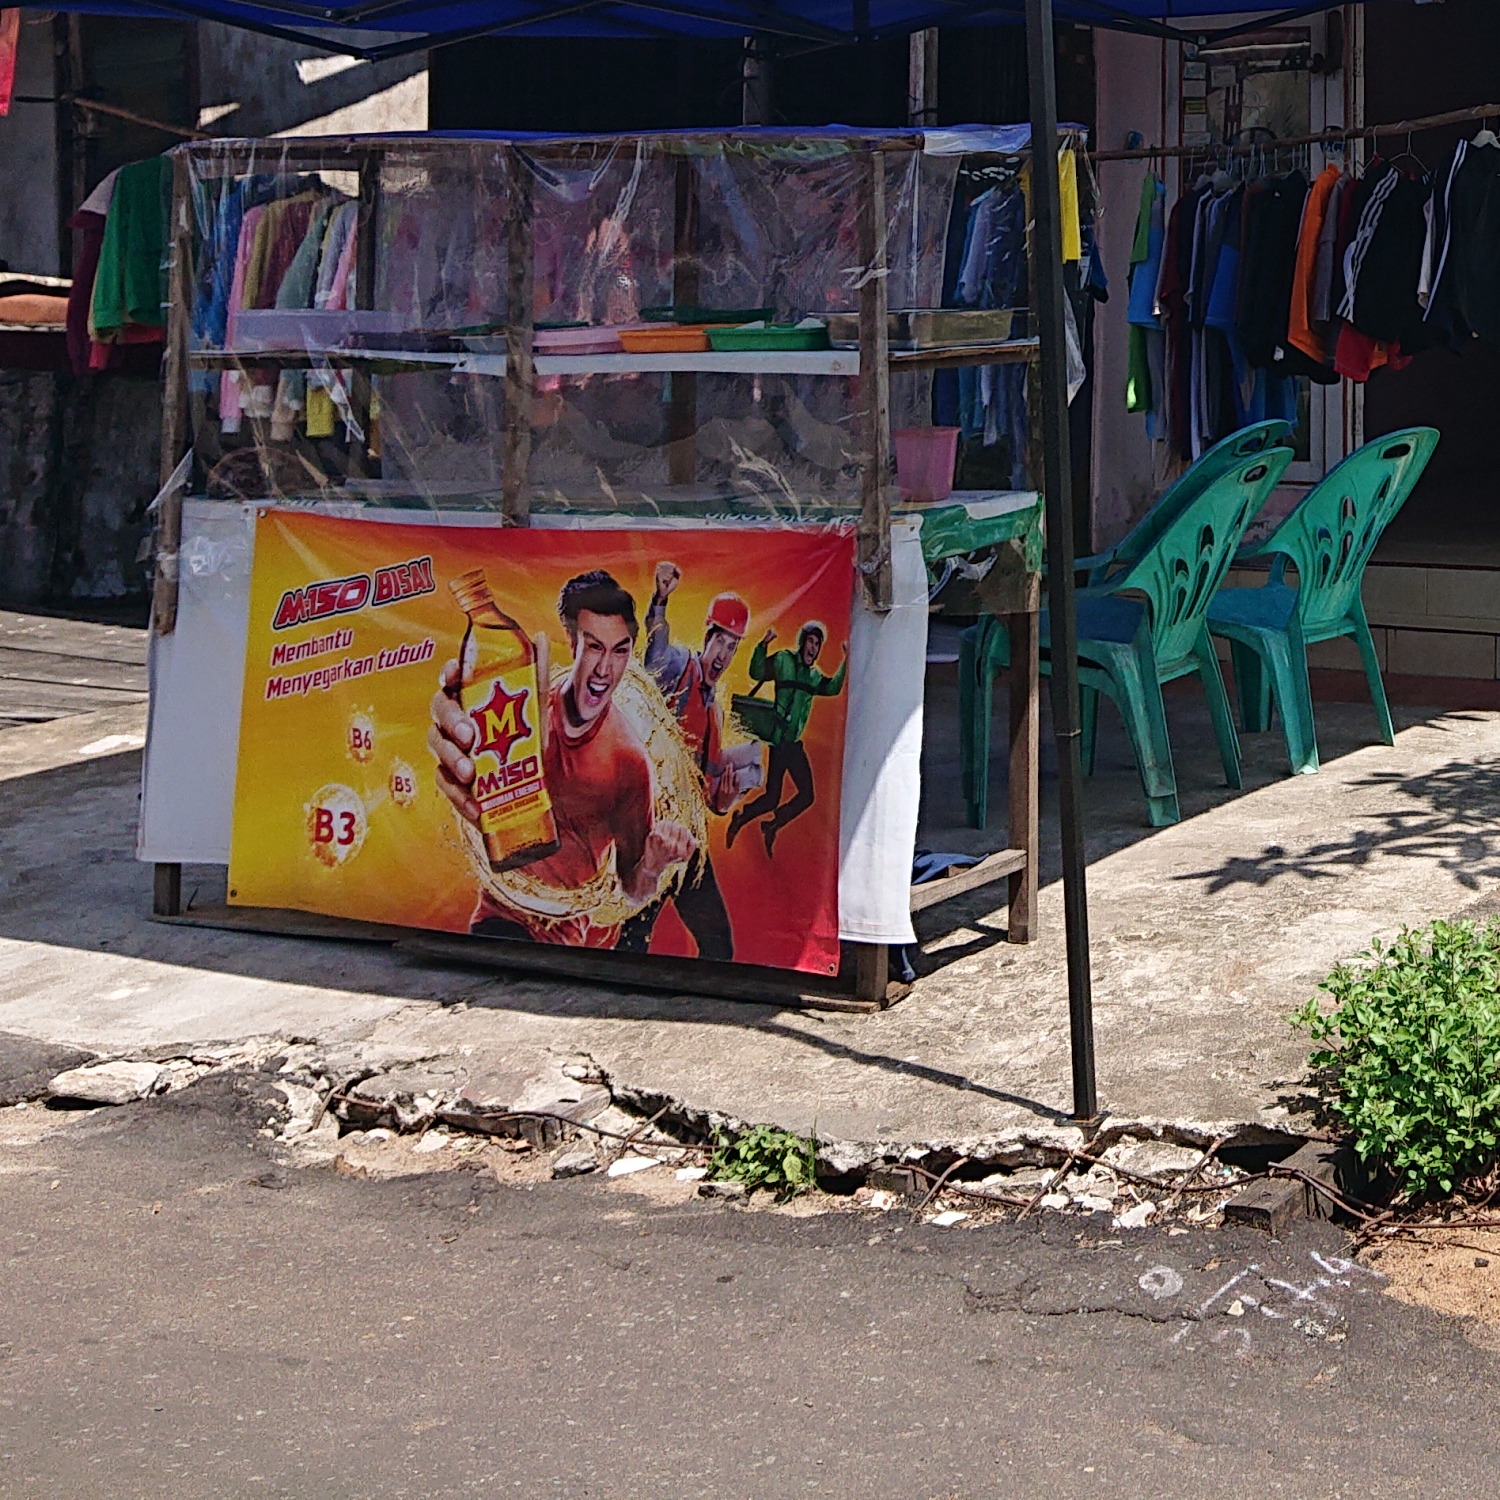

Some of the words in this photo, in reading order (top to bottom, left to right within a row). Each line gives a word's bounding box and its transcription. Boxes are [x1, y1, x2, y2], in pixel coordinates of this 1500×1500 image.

[274, 576, 370, 630] M-150
[373, 558, 434, 605] BISA!
[271, 627, 353, 667] Membantu
[266, 657, 374, 700] Menyegarkan
[378, 638, 434, 670] tubuh
[352, 727, 373, 751] B6
[483, 700, 520, 746] M
[394, 776, 412, 794] B5
[476, 754, 539, 798] M-150
[314, 807, 356, 846] B3
